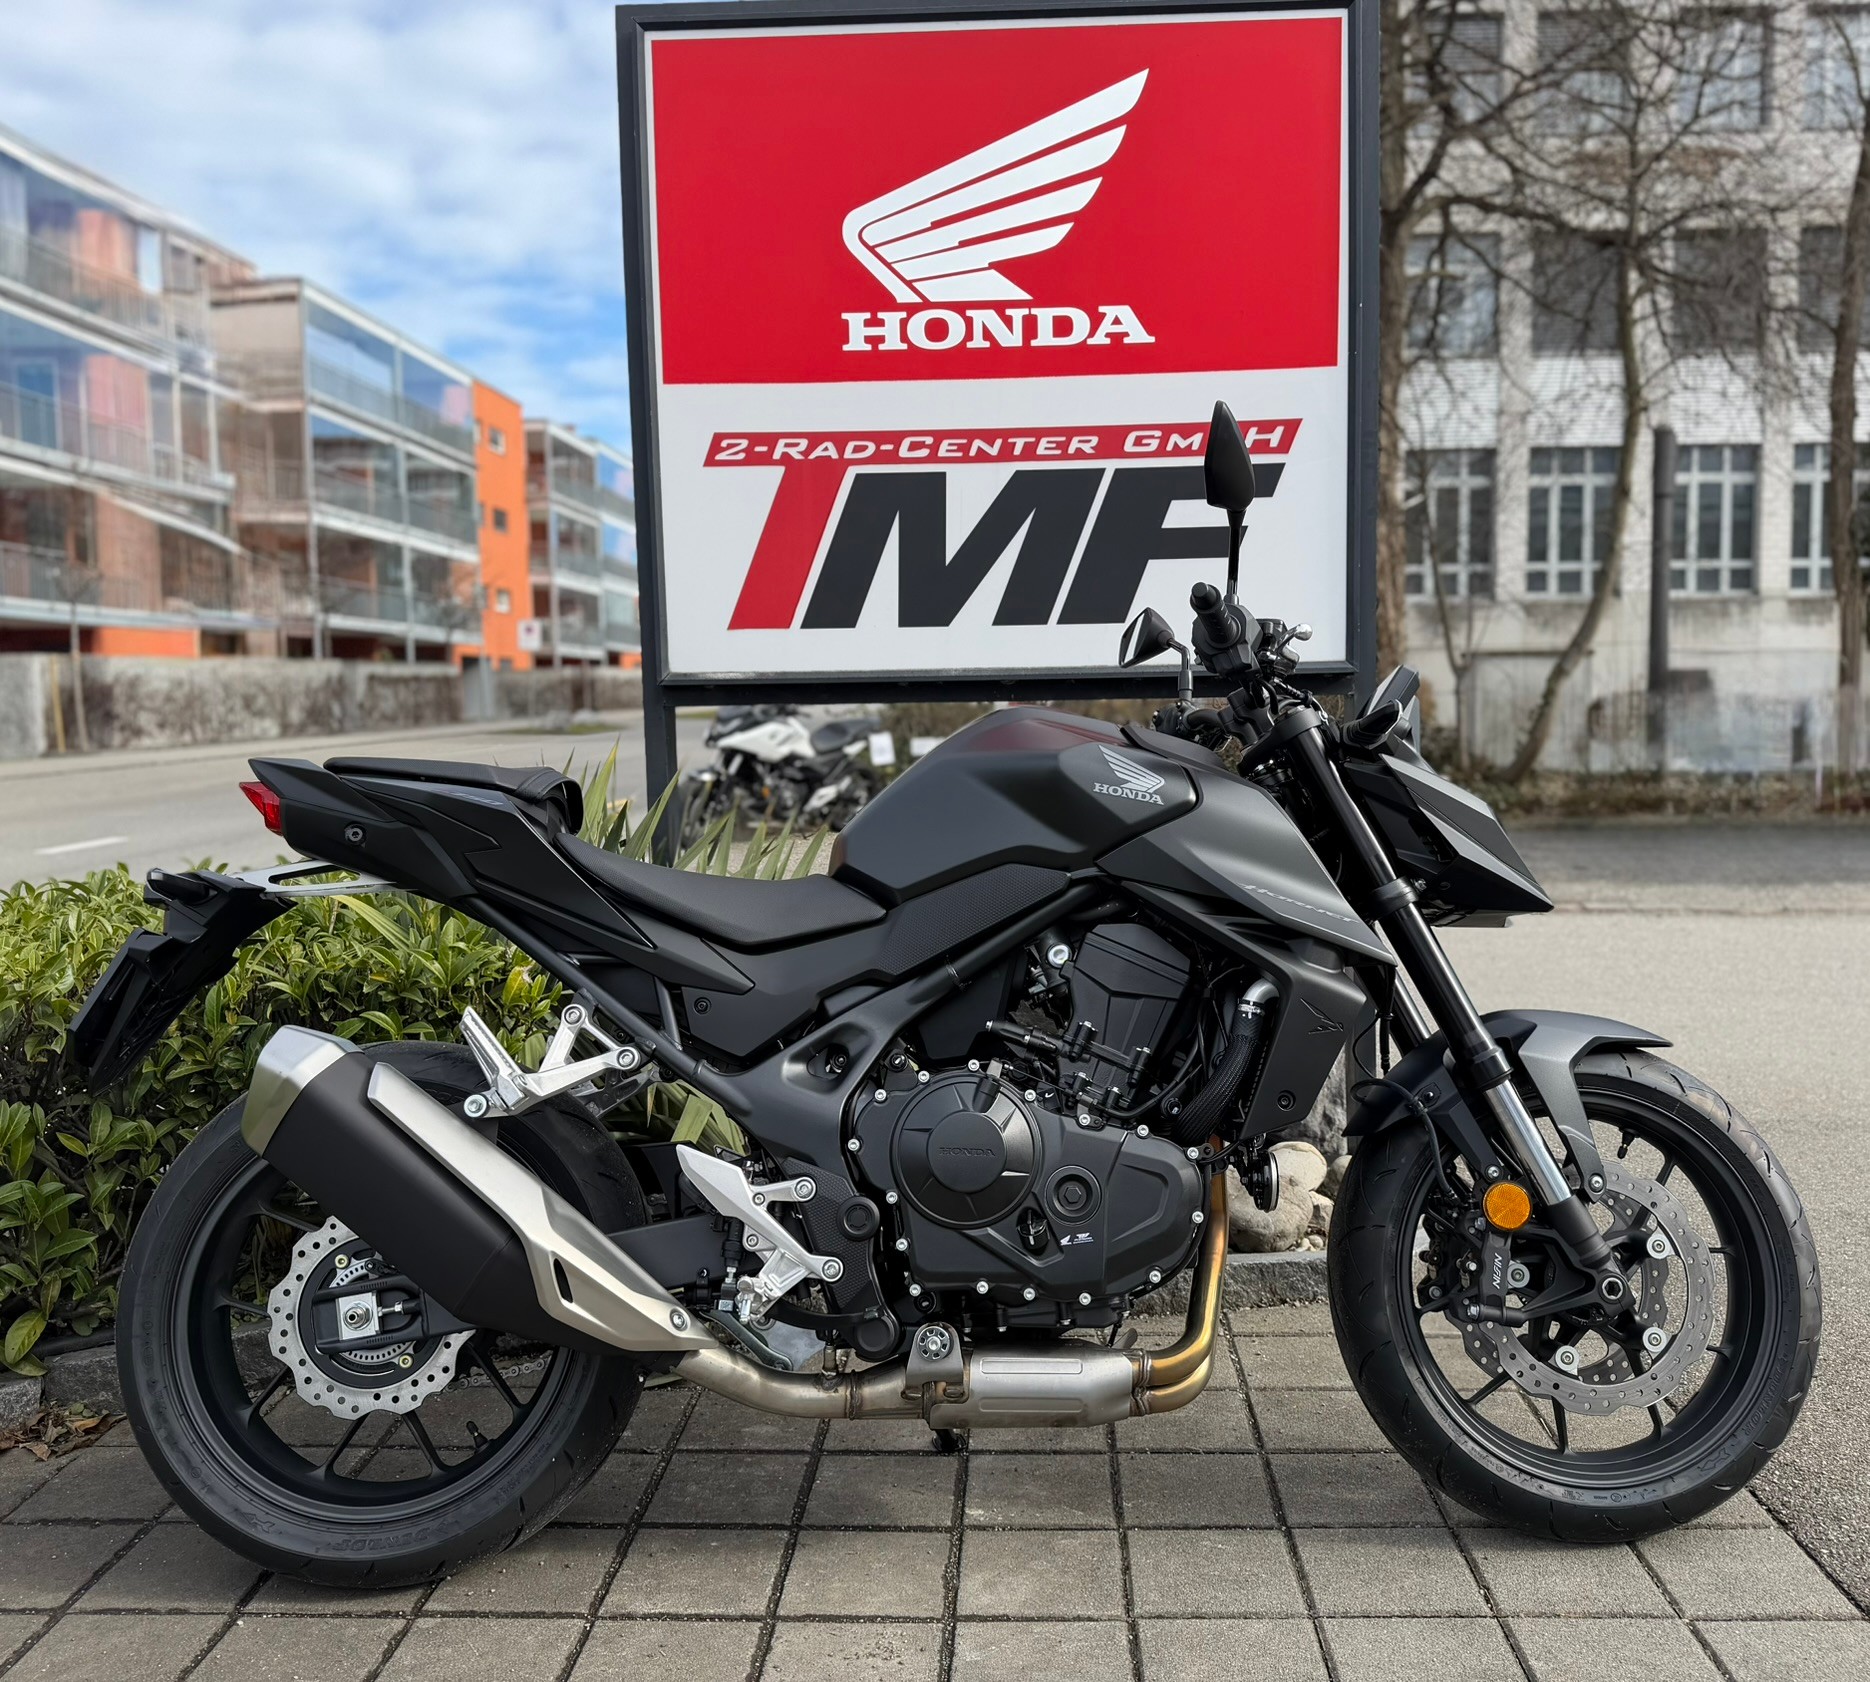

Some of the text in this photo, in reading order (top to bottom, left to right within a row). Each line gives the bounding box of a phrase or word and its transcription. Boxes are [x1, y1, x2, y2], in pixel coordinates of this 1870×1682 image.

[841, 305, 1155, 351] HONDA
[1123, 425, 1285, 453] GMH
[727, 462, 1286, 631] TMF
[1093, 782, 1165, 806] HONDA
[939, 1147, 996, 1157] HONDA
